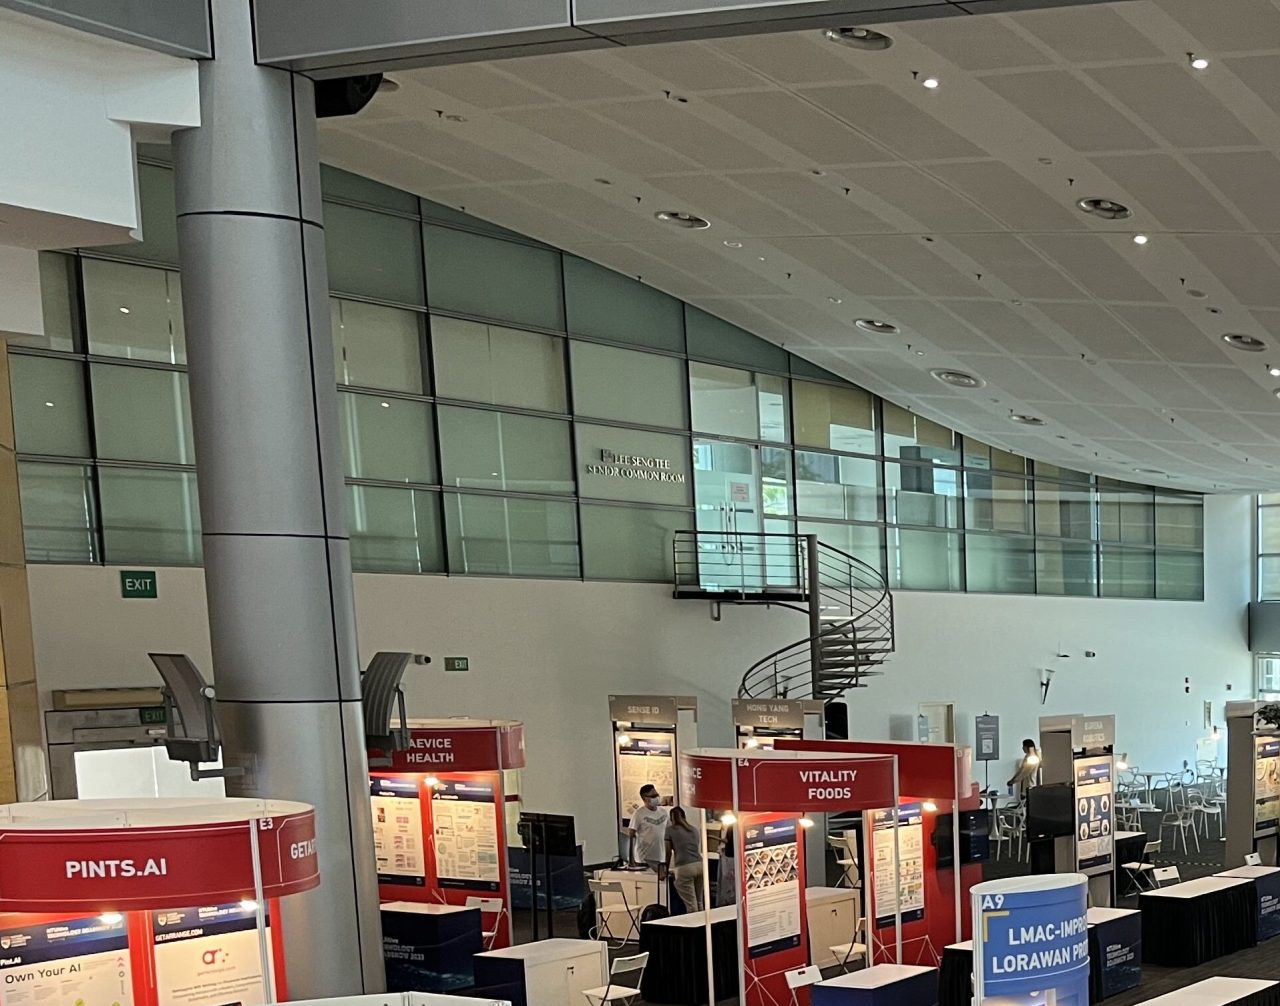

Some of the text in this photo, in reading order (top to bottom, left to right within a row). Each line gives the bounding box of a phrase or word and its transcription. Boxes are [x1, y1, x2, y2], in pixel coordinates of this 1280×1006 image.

[631, 456, 654, 468] SENG
[655, 458, 671, 470] TEE
[587, 465, 685, 484] SENIOR COMMON ROOM
[125, 578, 152, 592] EXIT
[454, 658, 468, 670] EXIT
[627, 704, 660, 715] SENSE ID
[769, 703, 789, 713] YANG
[144, 710, 165, 723] EXIT
[758, 715, 778, 724] TECH
[408, 738, 452, 749] AEVICE
[406, 752, 455, 763] HEALTH
[738, 758, 750, 767] E4
[800, 770, 857, 783] VITALITY
[808, 786, 852, 800] FOODS
[259, 817, 274, 831] E3
[65, 858, 167, 879] PINTS.AI
[982, 894, 1005, 909] A9
[992, 946, 1071, 974] LORAWAN
[5, 962, 82, 984] Own Your AI
